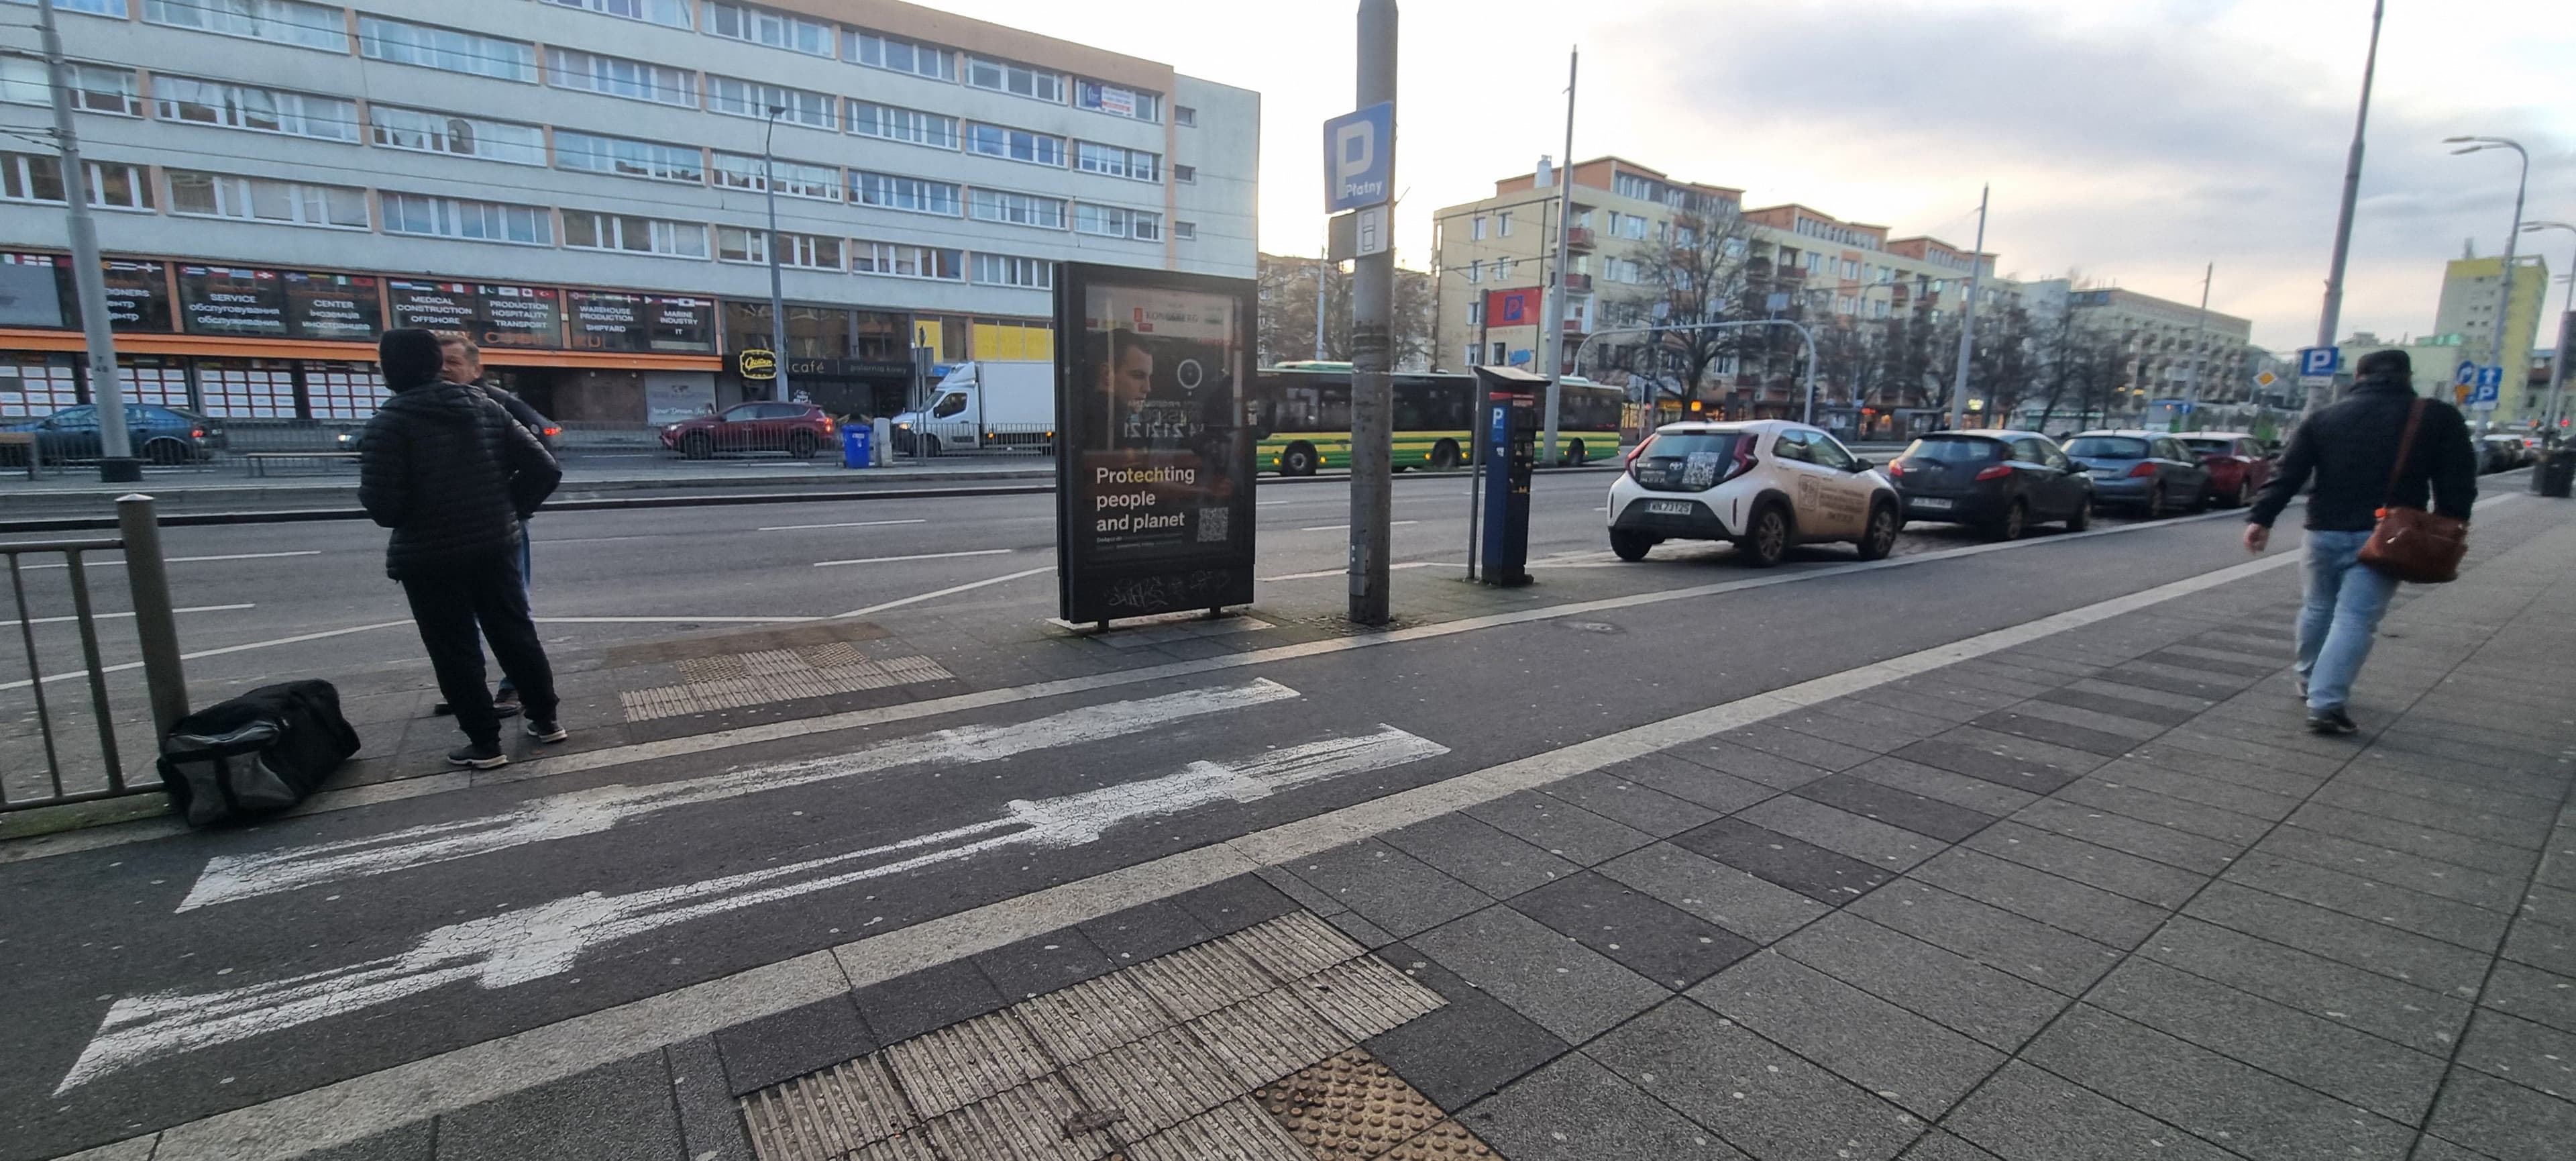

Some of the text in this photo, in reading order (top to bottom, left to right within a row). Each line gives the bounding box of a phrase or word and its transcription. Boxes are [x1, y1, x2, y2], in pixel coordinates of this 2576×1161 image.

[1336, 120, 1375, 200] P
[210, 293, 258, 303] SERVICE
[411, 296, 455, 305] MEDICAL
[107, 301, 135, 309] ентр
[313, 299, 355, 309] CENTER
[490, 301, 549, 310] PRODUCTION
[396, 305, 472, 314] CONSTRUCTION
[492, 309, 548, 319] HOSPITALITY
[580, 306, 631, 315] WAREHOUSE
[580, 313, 634, 322] PRODUCTION
[664, 311, 694, 319] MARINE
[411, 316, 461, 325] OFFSHORE
[495, 319, 548, 329] TRANSPORT
[660, 317, 698, 325] INDUSTRY
[586, 324, 626, 333] SHIPYARD
[2308, 350, 2330, 372] P
[792, 360, 825, 374] café
[2478, 386, 2493, 399] P
[1493, 407, 1503, 425] P
[1096, 466, 1195, 485] Protechting
[1096, 491, 1156, 511] people
[1096, 511, 1185, 533] and planet
